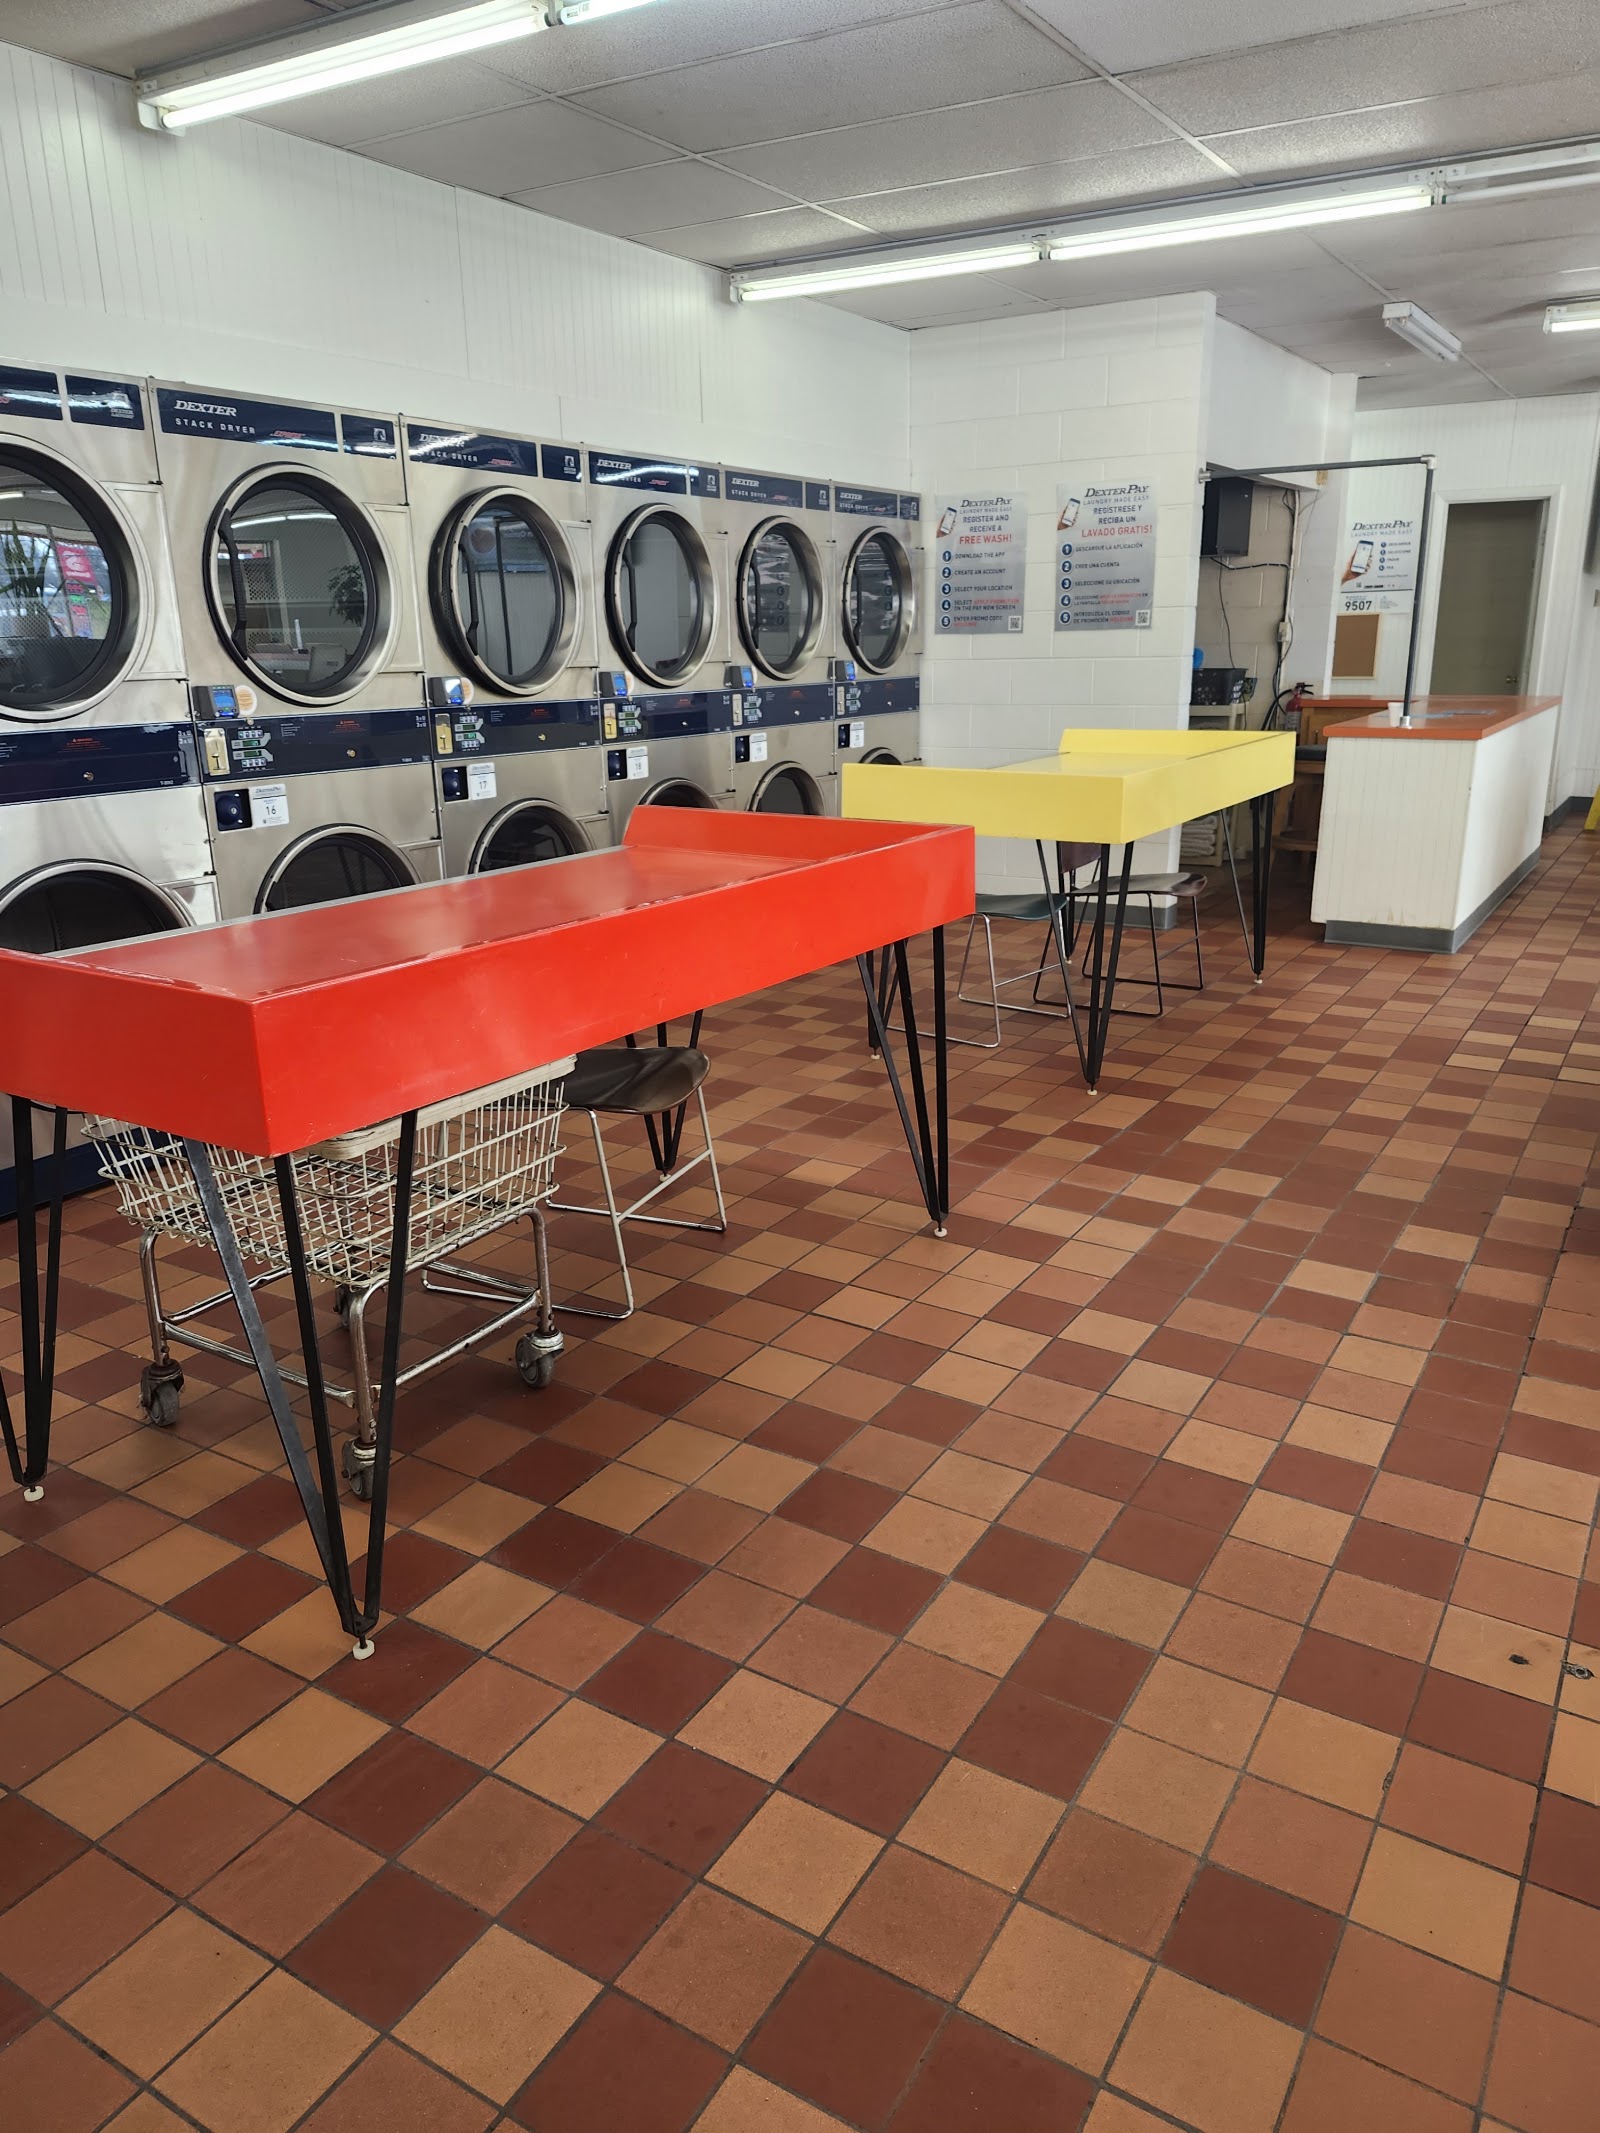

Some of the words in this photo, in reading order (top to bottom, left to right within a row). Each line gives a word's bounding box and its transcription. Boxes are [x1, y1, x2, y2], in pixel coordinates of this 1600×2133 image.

[174, 400, 238, 417] DEXTER
[175, 418, 214, 429] STACK
[220, 423, 256, 434] DRYER
[452, 453, 478, 462] DRYER
[597, 460, 632, 470] DEXTER
[731, 478, 760, 488] DEXTER
[1093, 505, 1136, 514] REGÍSTRESE
[1082, 528, 1115, 537] LAVADO
[1118, 525, 1152, 534] GRATIS!
[960, 536, 981, 544] FREE
[983, 534, 1012, 543] WASH!
[1345, 601, 1372, 611] 9507
[479, 781, 487, 790] 17
[266, 805, 276, 815] 16
